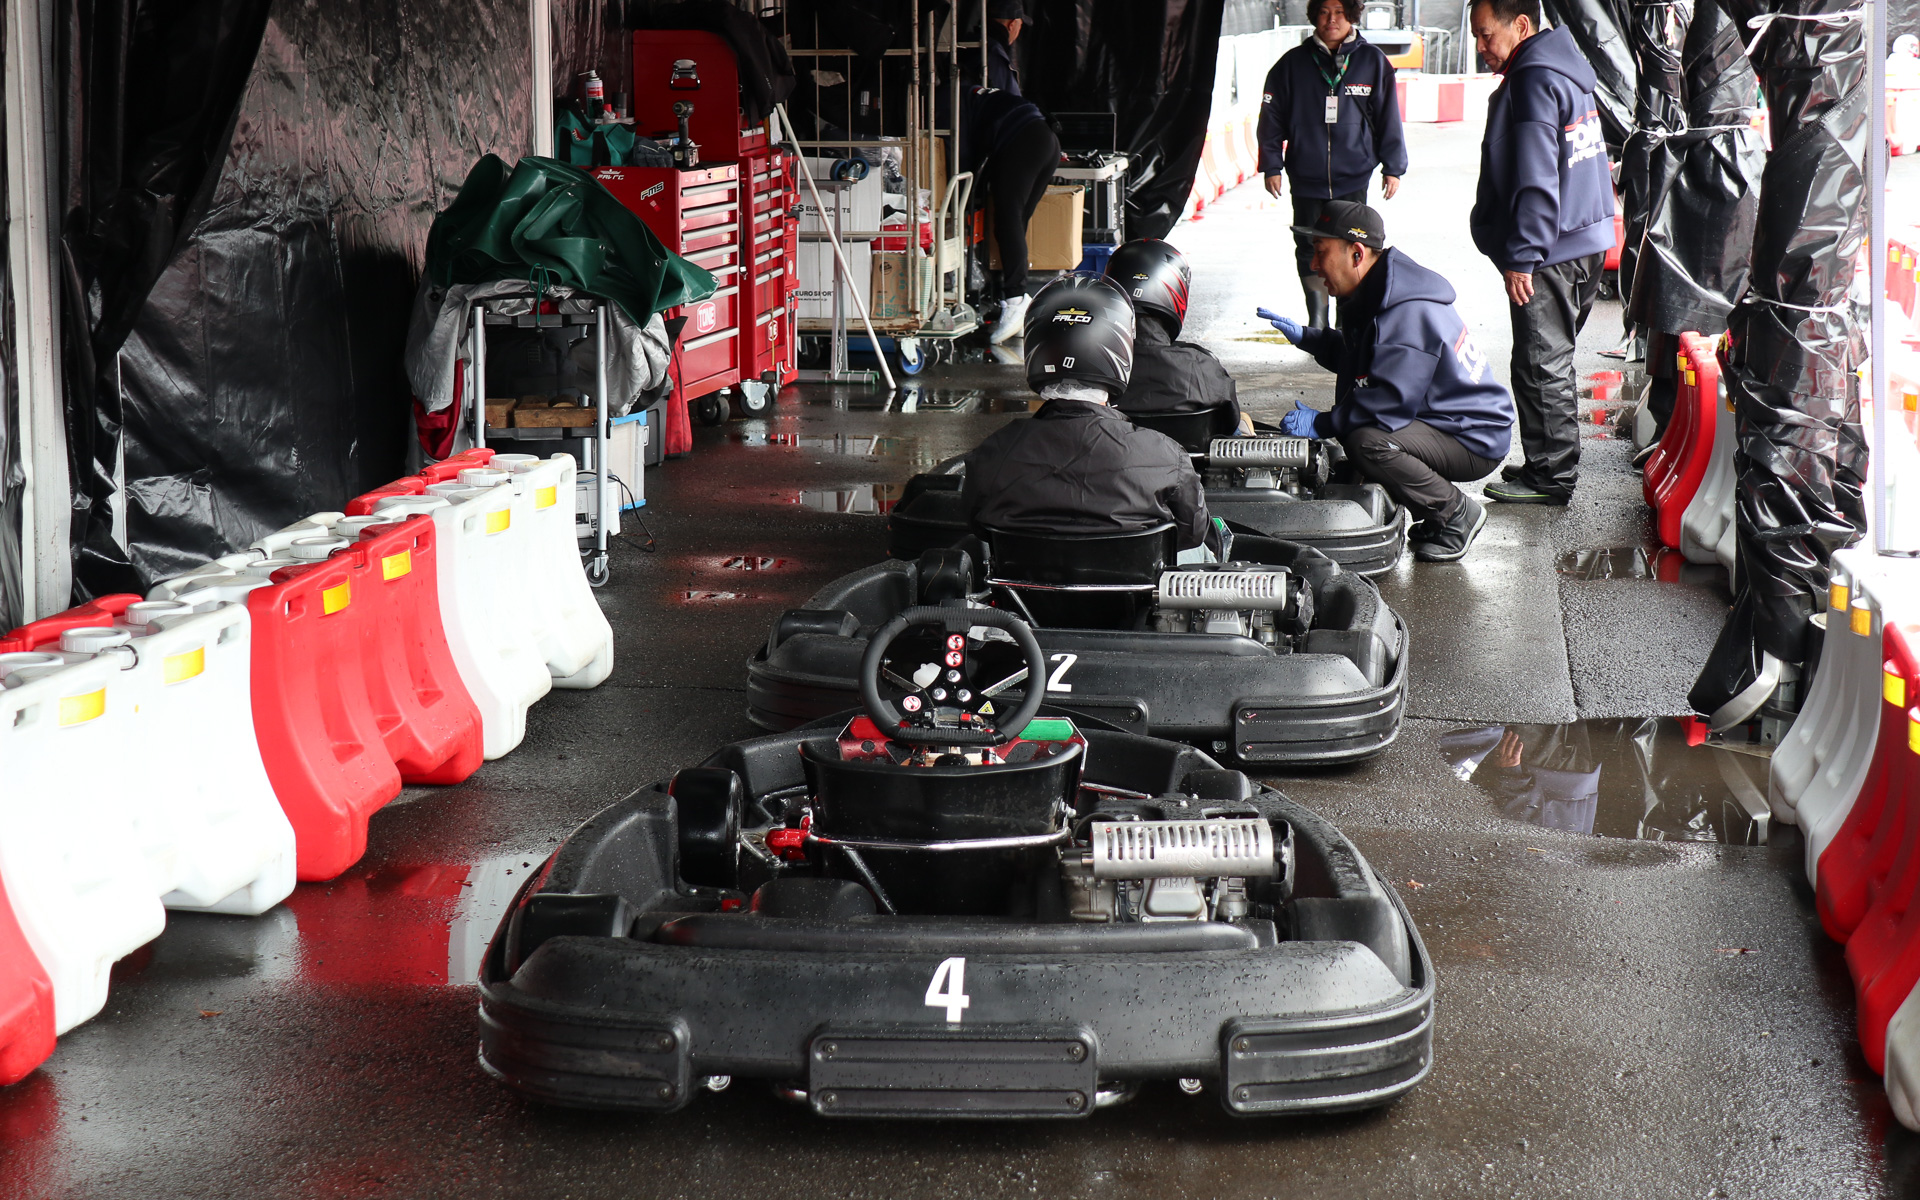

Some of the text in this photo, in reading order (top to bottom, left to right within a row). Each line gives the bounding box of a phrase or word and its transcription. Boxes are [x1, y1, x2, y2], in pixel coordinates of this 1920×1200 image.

[698, 307, 715, 328] TONE
[1052, 314, 1092, 323] FALCO
[1047, 653, 1078, 692] 2
[925, 957, 970, 1023] 4
